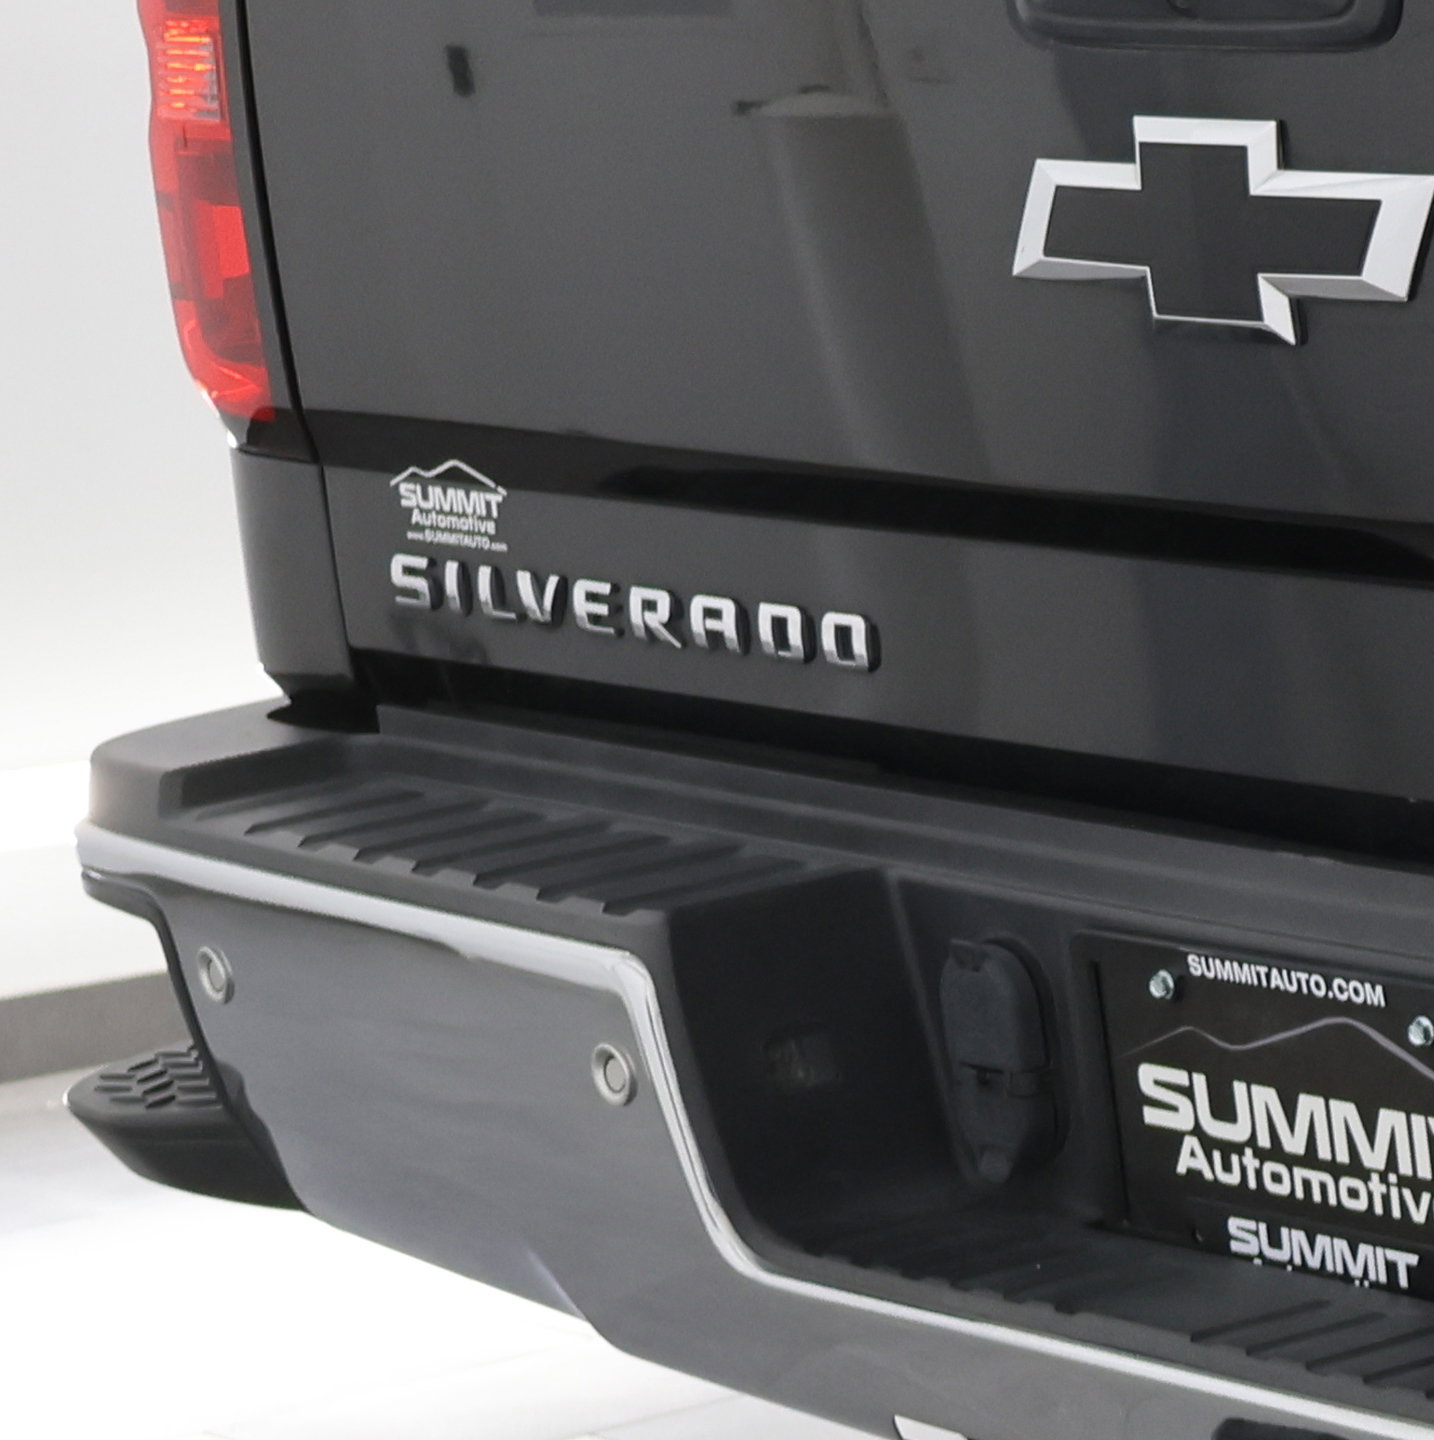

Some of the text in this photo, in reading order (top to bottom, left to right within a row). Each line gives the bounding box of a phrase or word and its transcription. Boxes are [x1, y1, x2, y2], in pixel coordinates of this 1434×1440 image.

[398, 482, 503, 519] SUMMIT
[411, 508, 496, 535] Automotive
[390, 553, 874, 672] SILVERADO
[1186, 953, 1386, 1009] SUMMITAUTO.COM
[1227, 1215, 1420, 1289] SUMMIT
